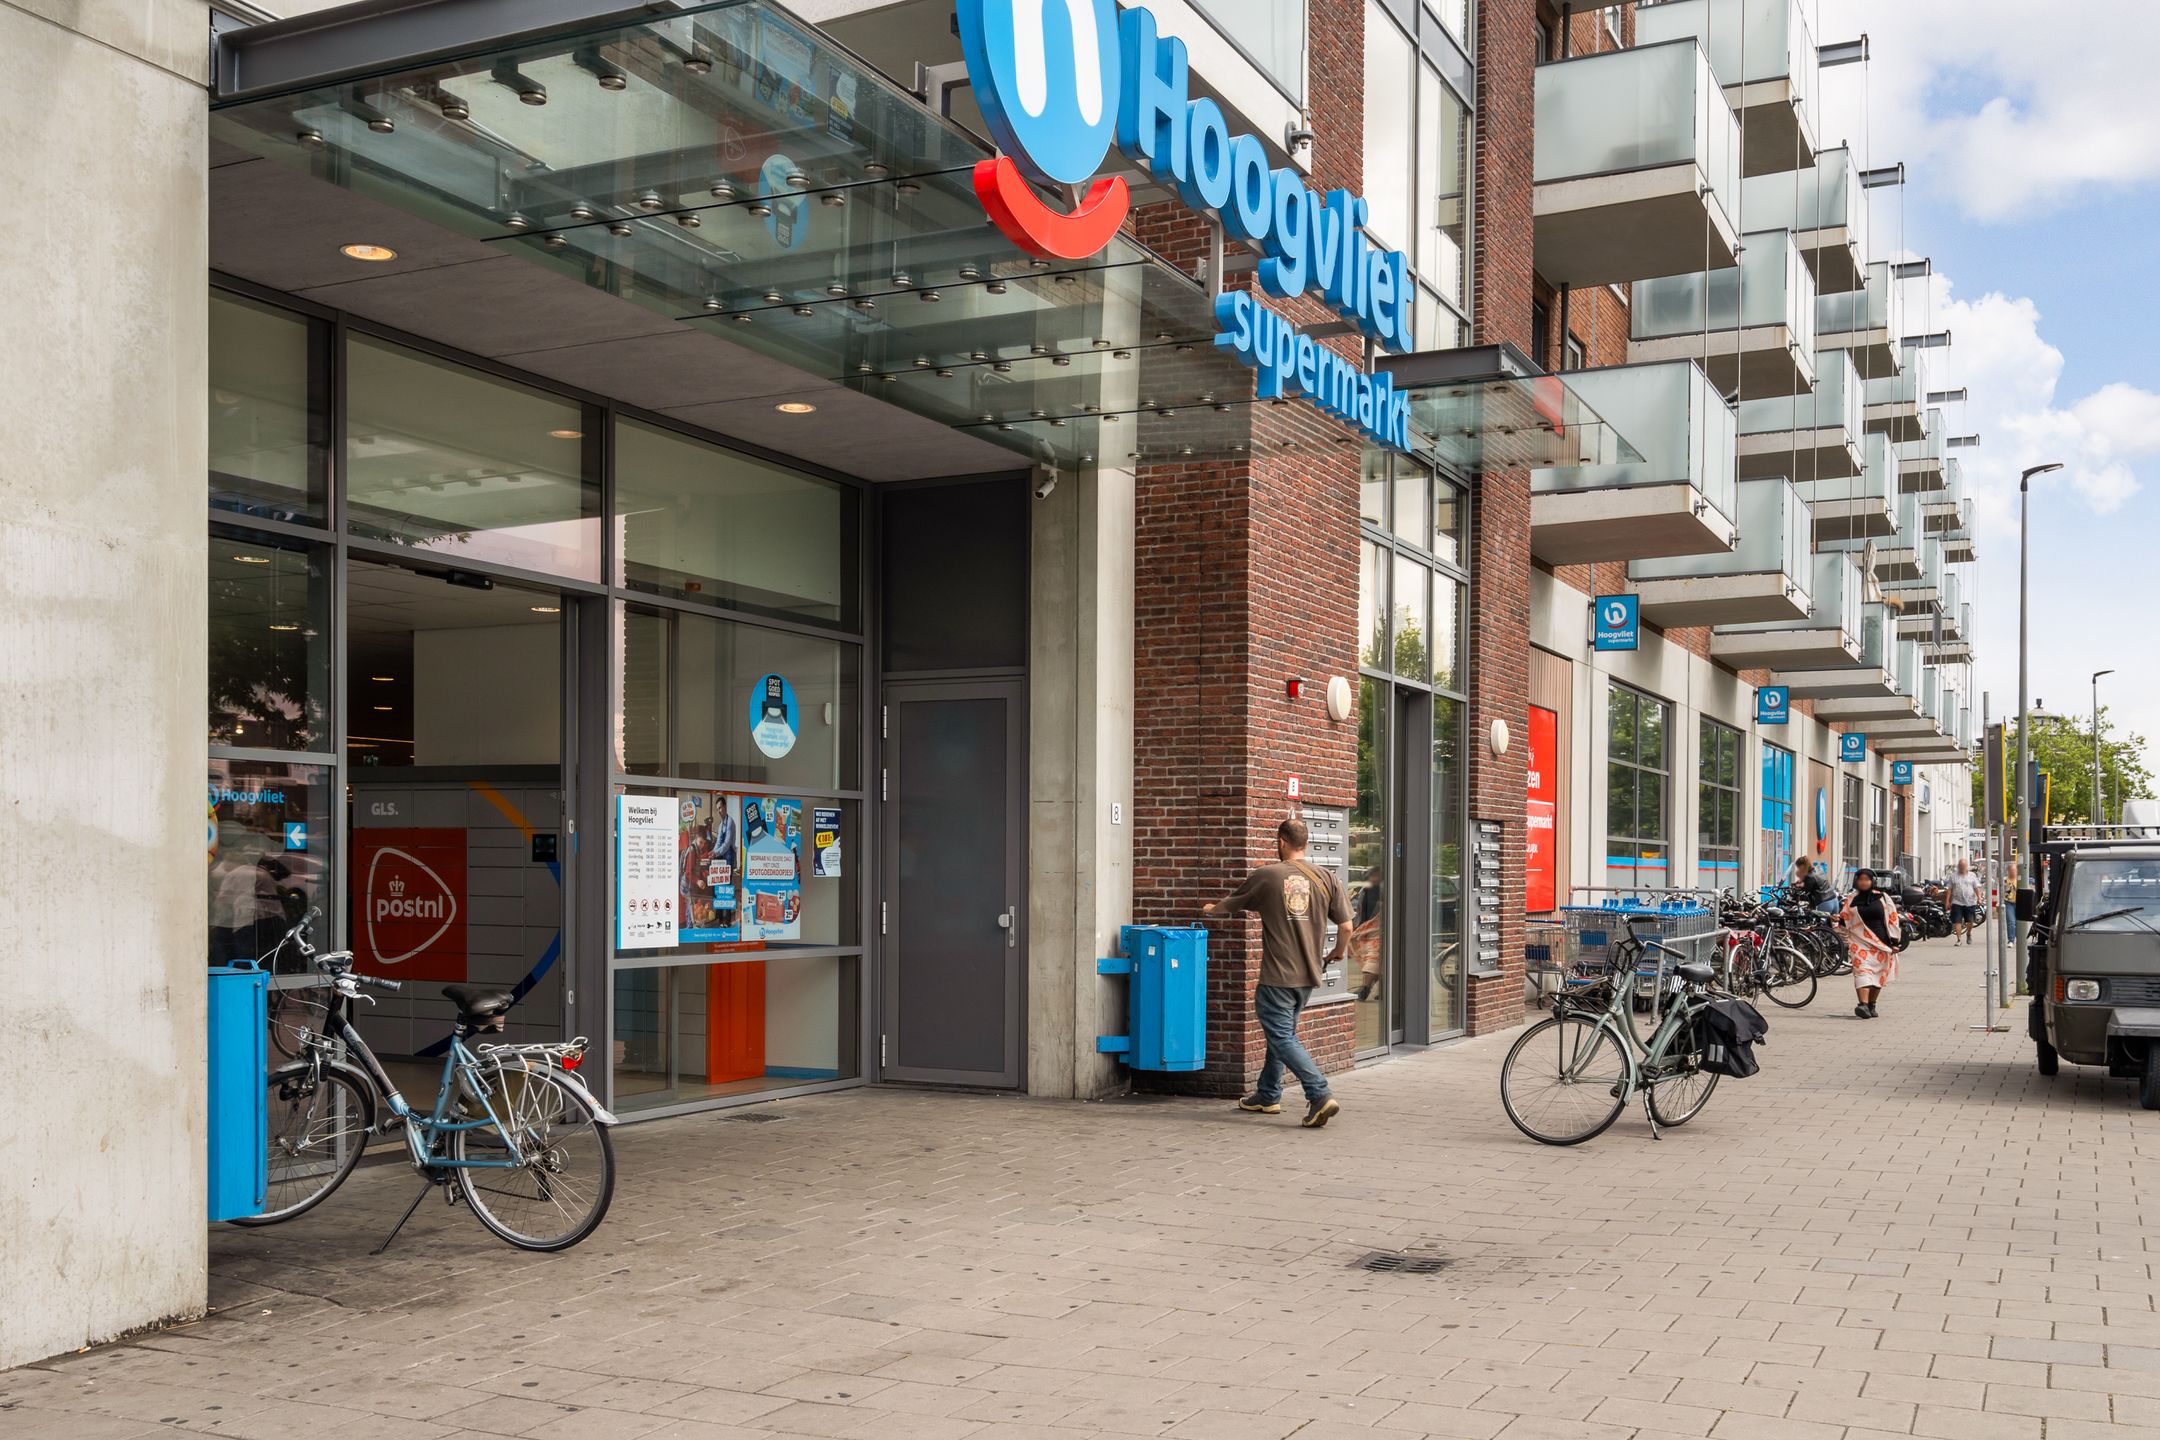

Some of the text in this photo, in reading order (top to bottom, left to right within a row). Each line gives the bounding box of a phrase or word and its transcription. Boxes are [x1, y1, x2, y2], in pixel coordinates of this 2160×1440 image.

[1118, 7, 1413, 353] Hoogvliet
[1214, 290, 1412, 452] supermarkt
[1598, 631, 1633, 639] Hoogvliet
[221, 788, 285, 805] Hoogvliet
[628, 816, 654, 825] Hoogvliet
[1114, 806, 1119, 821] 8
[1527, 814, 1552, 831] upermarkt
[377, 893, 444, 923] postnl
